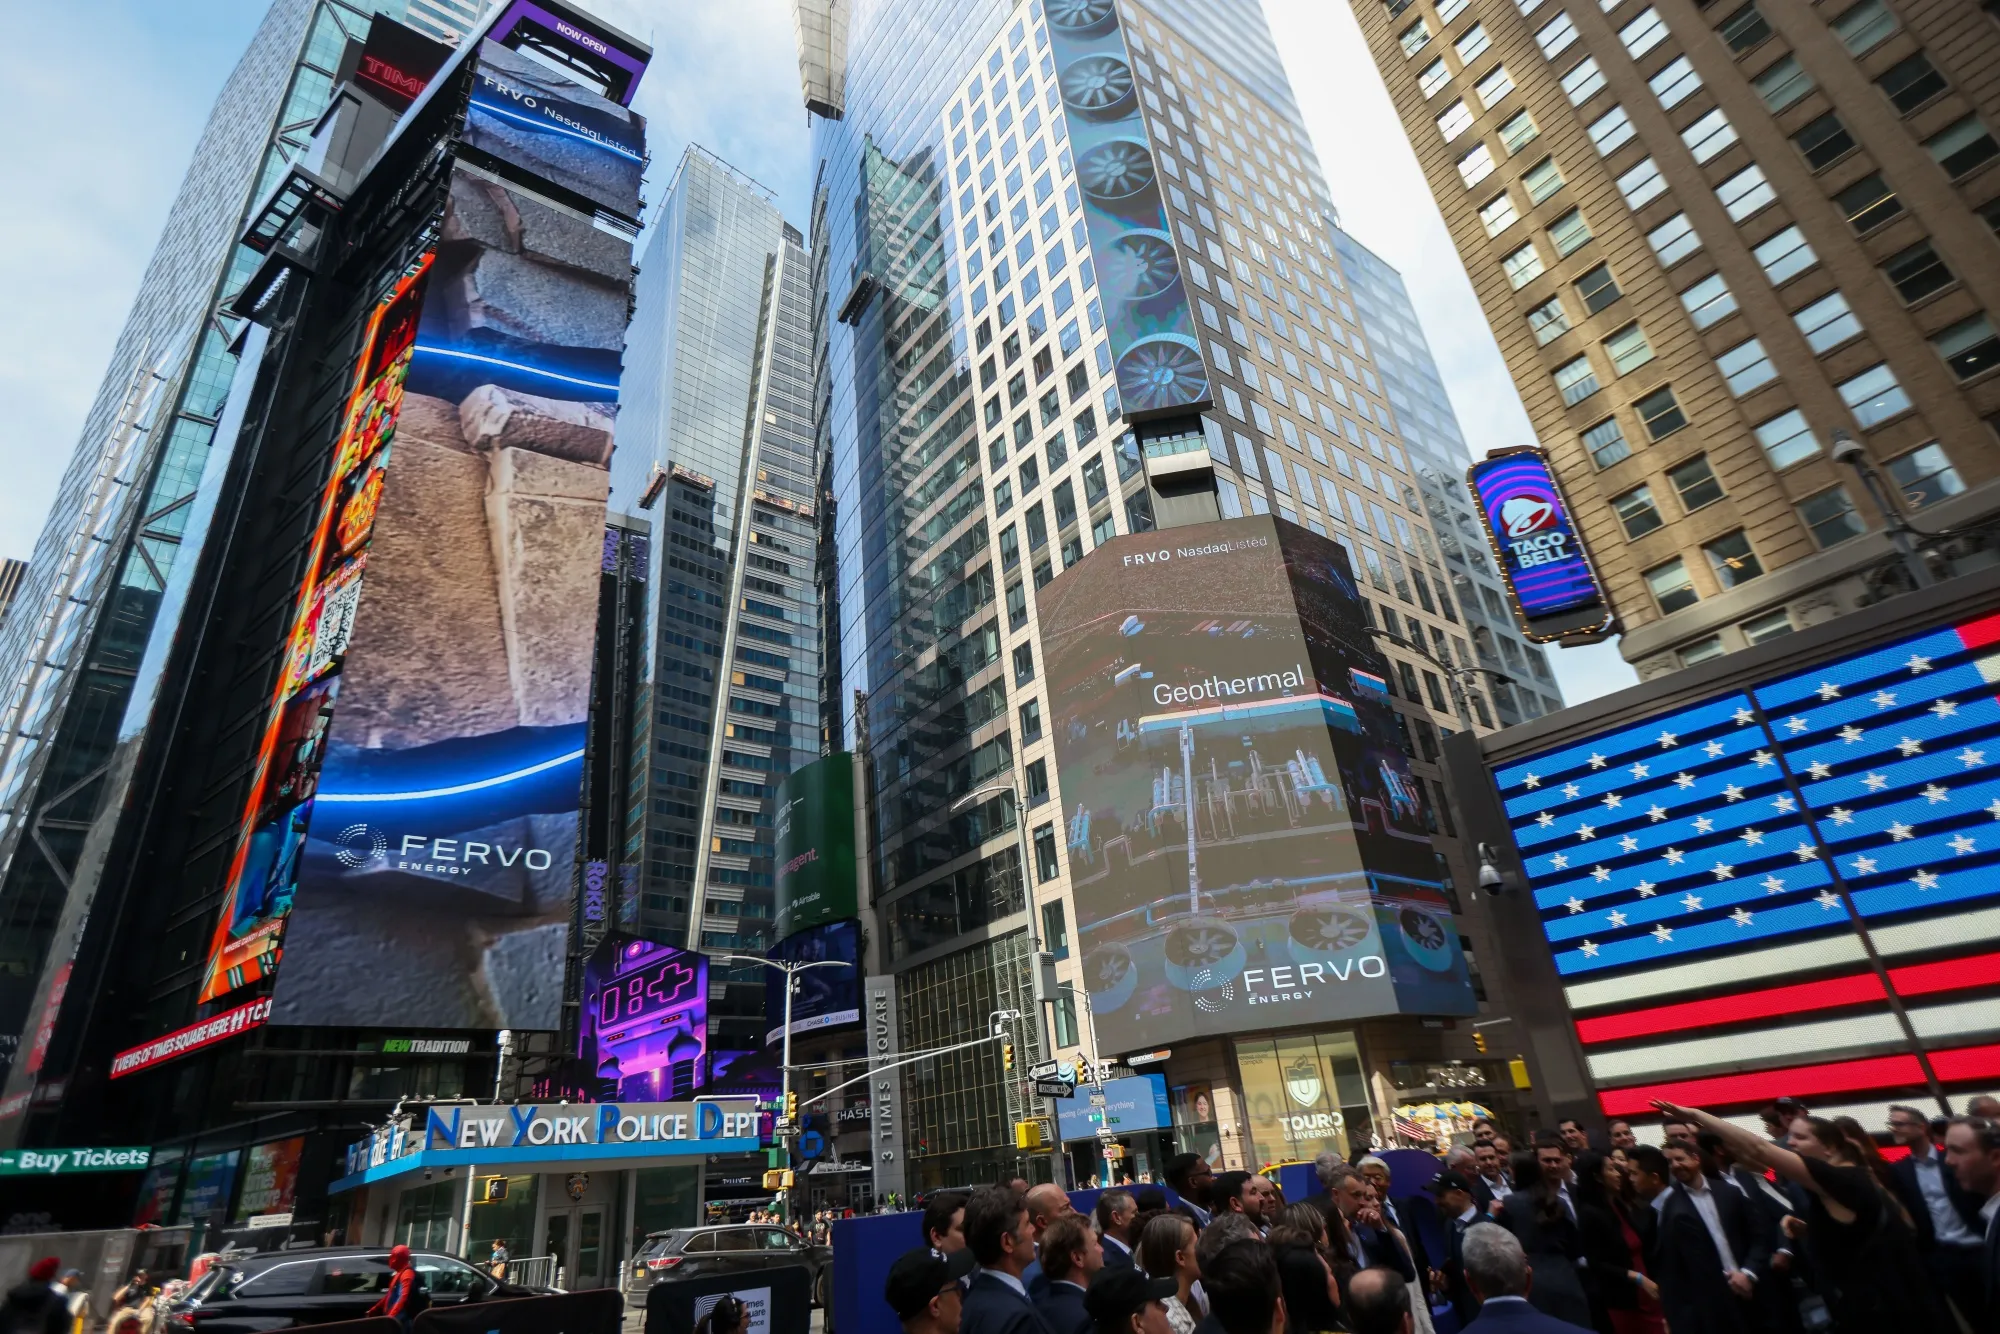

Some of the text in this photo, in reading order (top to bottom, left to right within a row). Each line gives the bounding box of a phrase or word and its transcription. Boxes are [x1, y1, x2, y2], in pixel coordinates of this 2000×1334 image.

[556, 22, 607, 54] NOW OPEN
[483, 76, 537, 108] FRVO
[1508, 532, 1566, 556] TACO
[1123, 550, 1171, 567] FRVO
[1517, 546, 1574, 569] BELL
[1153, 664, 1305, 706] Geothermal
[401, 834, 552, 871] FERVO
[399, 861, 471, 875] ENERGY
[799, 891, 820, 906] Airtable
[1243, 955, 1386, 992] FERVO
[1248, 990, 1313, 1005] ENERGY
[118, 1050, 142, 1072] VIEWS
[141, 1045, 153, 1063] OF
[152, 1038, 175, 1059] TIMES
[174, 1024, 208, 1050] SQUARE
[206, 1016, 231, 1039] HERE
[875, 989, 894, 1161] 3 TIMES SQUARE
[1032, 1065, 1055, 1077] ONE WAY
[1041, 1085, 1069, 1094] ONE WAY
[836, 1107, 871, 1121] CHASE
[1278, 1111, 1344, 1131] TOURO
[1283, 1127, 1344, 1141] UNIVERSITY
[19, 1148, 150, 1173] Buy Tickets
[747, 1299, 765, 1309] imes
[750, 1308, 766, 1319] uare
